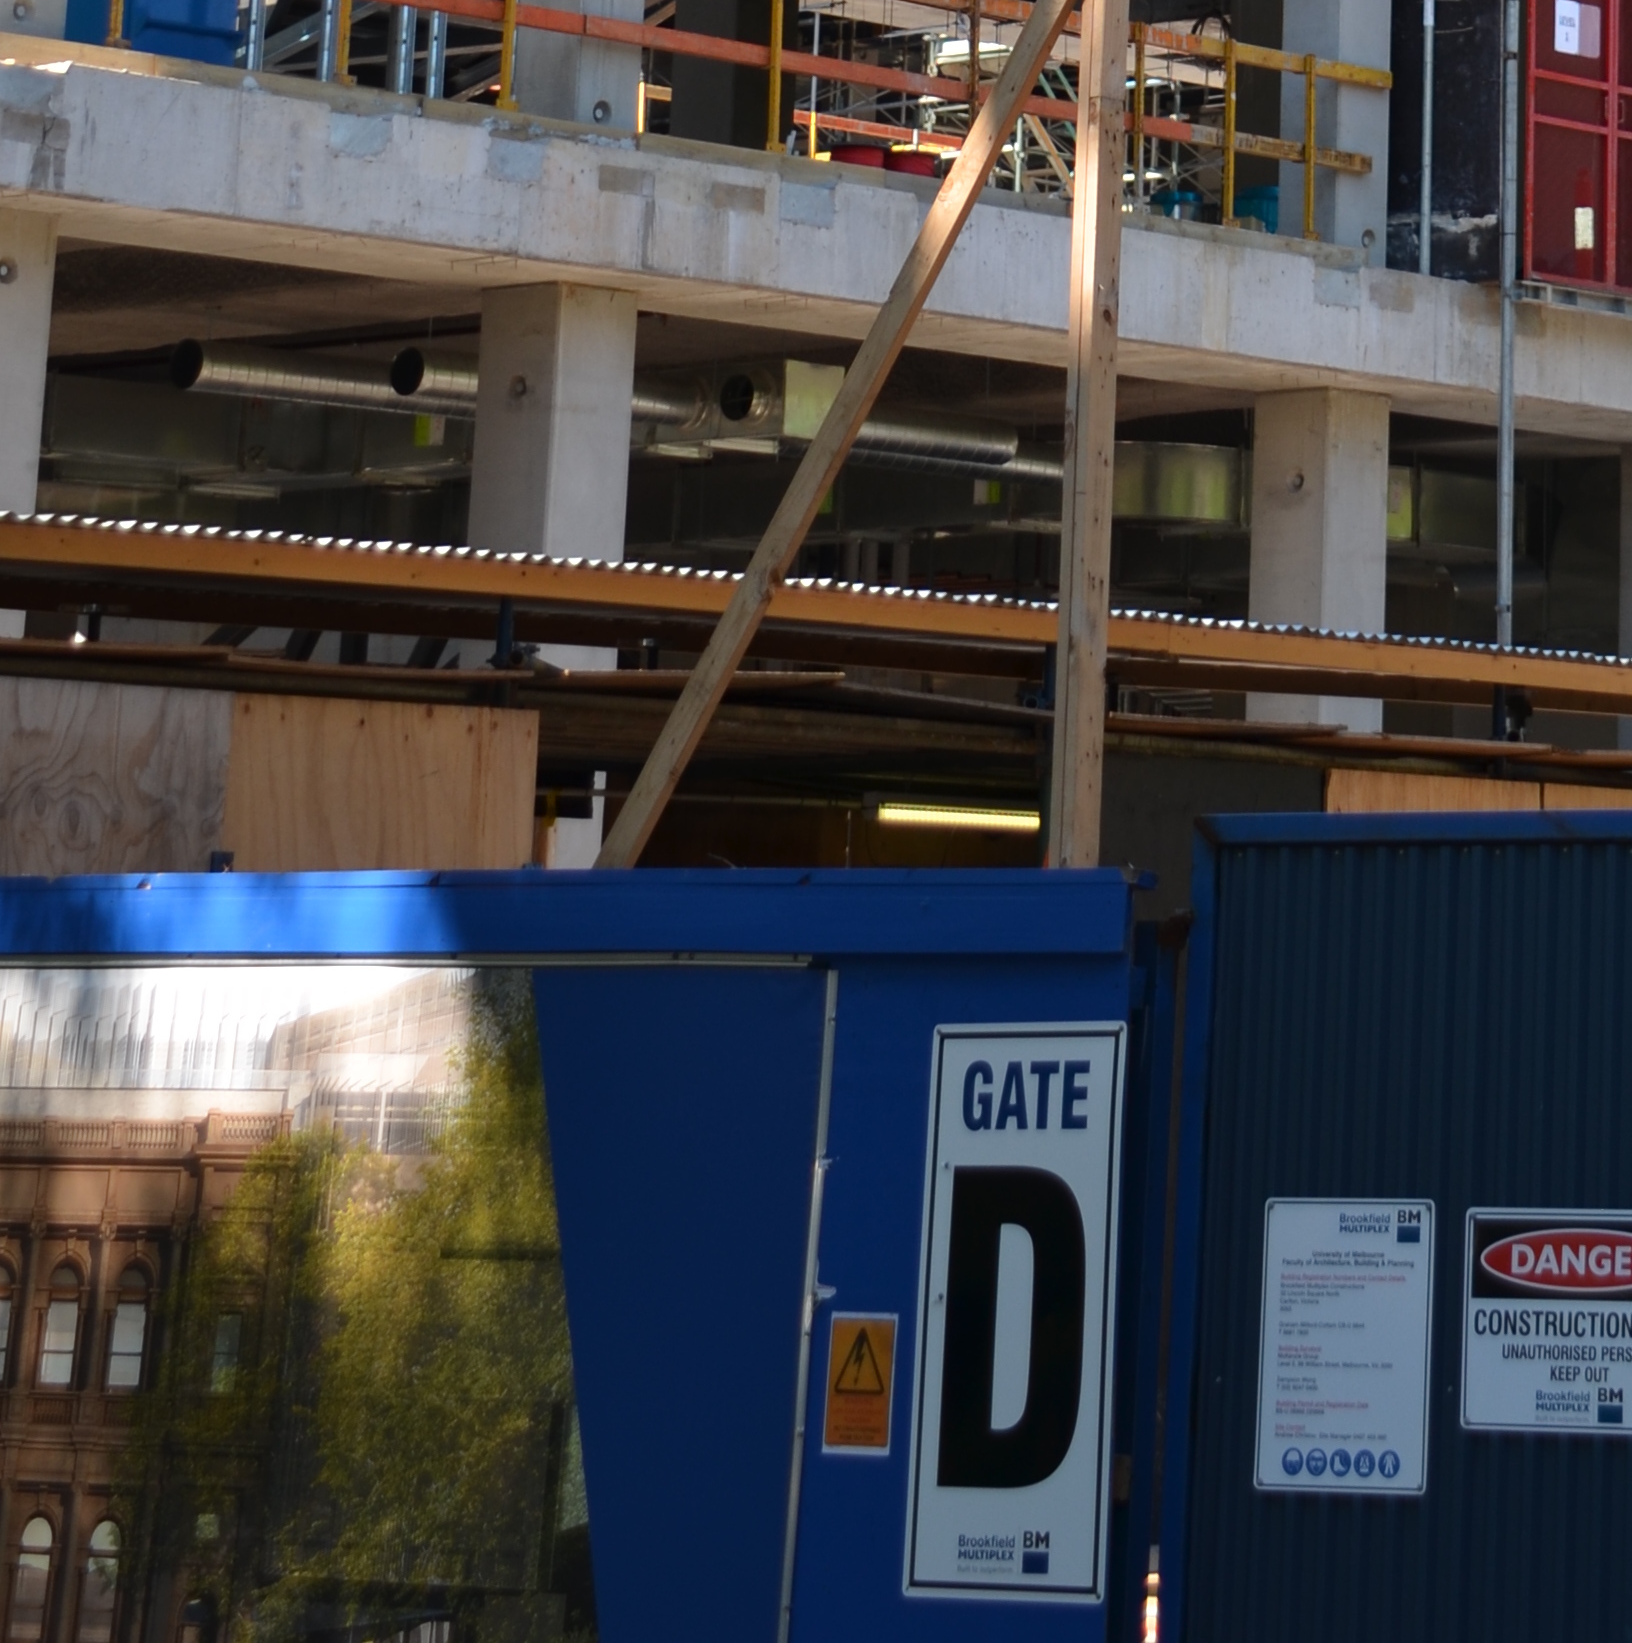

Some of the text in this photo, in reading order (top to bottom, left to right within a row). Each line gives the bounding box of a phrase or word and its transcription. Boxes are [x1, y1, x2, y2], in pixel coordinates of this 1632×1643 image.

[963, 1060, 1091, 1132] GATE
[1339, 1213, 1391, 1224] Brookfield
[1397, 1210, 1421, 1224] BM
[1339, 1225, 1390, 1233] MULTIPLEX
[937, 1165, 1086, 1489] D
[1502, 1343, 1596, 1361] UNAUTHORISED
[1550, 1366, 1609, 1383] KEEP OUT
[1536, 1390, 1591, 1402] Brookfield
[1598, 1387, 1623, 1403] BM
[1536, 1402, 1590, 1412] MULTIPLEX
[958, 1534, 1015, 1548] Brookfield
[1023, 1530, 1050, 1549] BM
[958, 1549, 1014, 1561] MULTIPLEX
